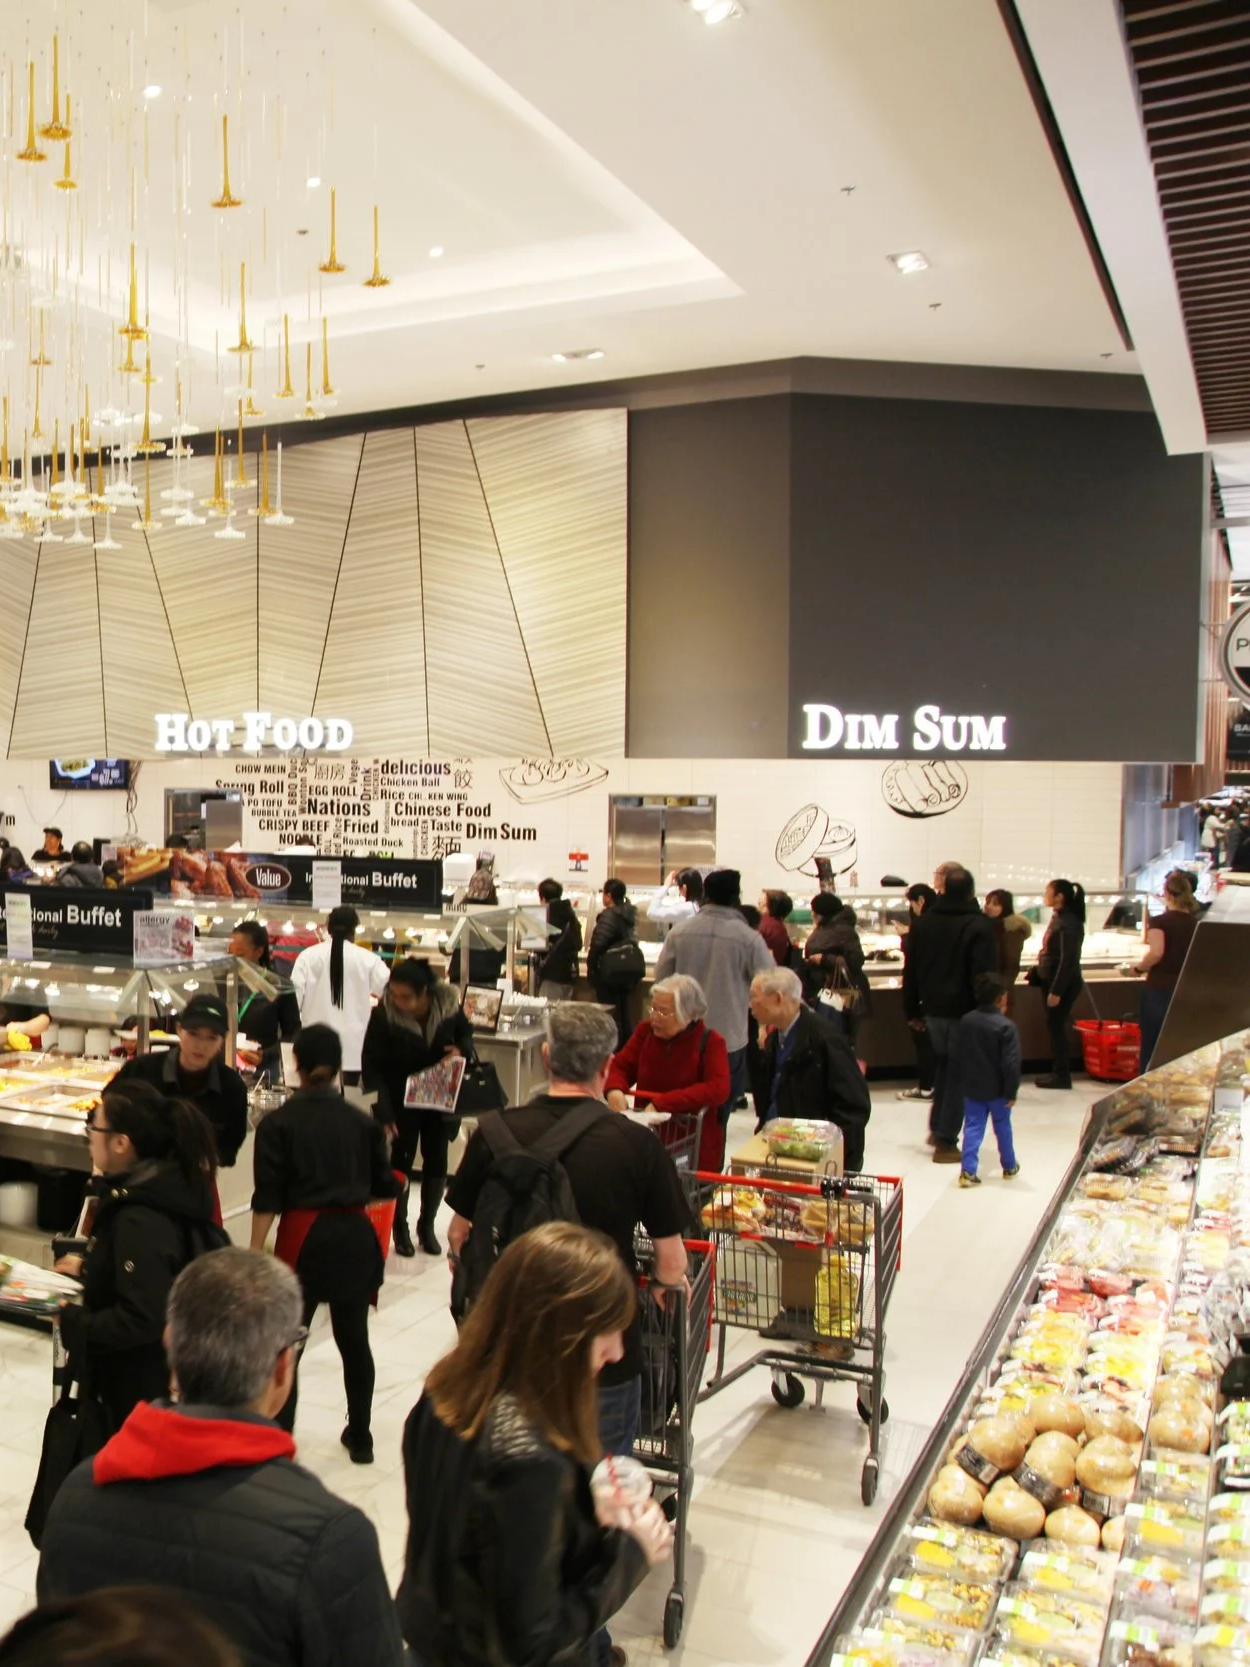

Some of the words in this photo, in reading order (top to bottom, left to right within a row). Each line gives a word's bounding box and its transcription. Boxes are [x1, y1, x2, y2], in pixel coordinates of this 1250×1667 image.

[1237, 638, 1250, 651] P
[154, 713, 235, 751] HOT
[243, 712, 354, 751] FOOD
[802, 704, 899, 749] DIM
[913, 705, 1007, 751] SUM
[235, 764, 261, 774] CHOW
[264, 764, 286, 774] MEIN
[381, 759, 452, 775] delicious
[259, 780, 284, 794] Roll
[380, 776, 418, 787] Chicken
[421, 777, 440, 787] Ball
[308, 785, 329, 796] EGG
[332, 785, 358, 797] ROLL
[380, 788, 405, 801] Rice
[446, 792, 468, 801] WING
[262, 799, 283, 808] TOFU
[307, 798, 371, 817] Nations
[394, 801, 451, 818] Chinese
[456, 803, 491, 818] Food
[251, 808, 280, 817] BUBBLE
[283, 809, 297, 818] TEA
[258, 819, 298, 832] CRISPY
[302, 820, 330, 833] BEEF
[343, 818, 379, 835] Fried
[390, 816, 419, 828] bread
[429, 819, 463, 832] Taste
[466, 822, 497, 839] Dim
[500, 822, 537, 841] Sum
[381, 837, 404, 848] Duck
[255, 868, 282, 888] Value
[371, 871, 418, 889] Buffet
[66, 904, 122, 928] Buffet
